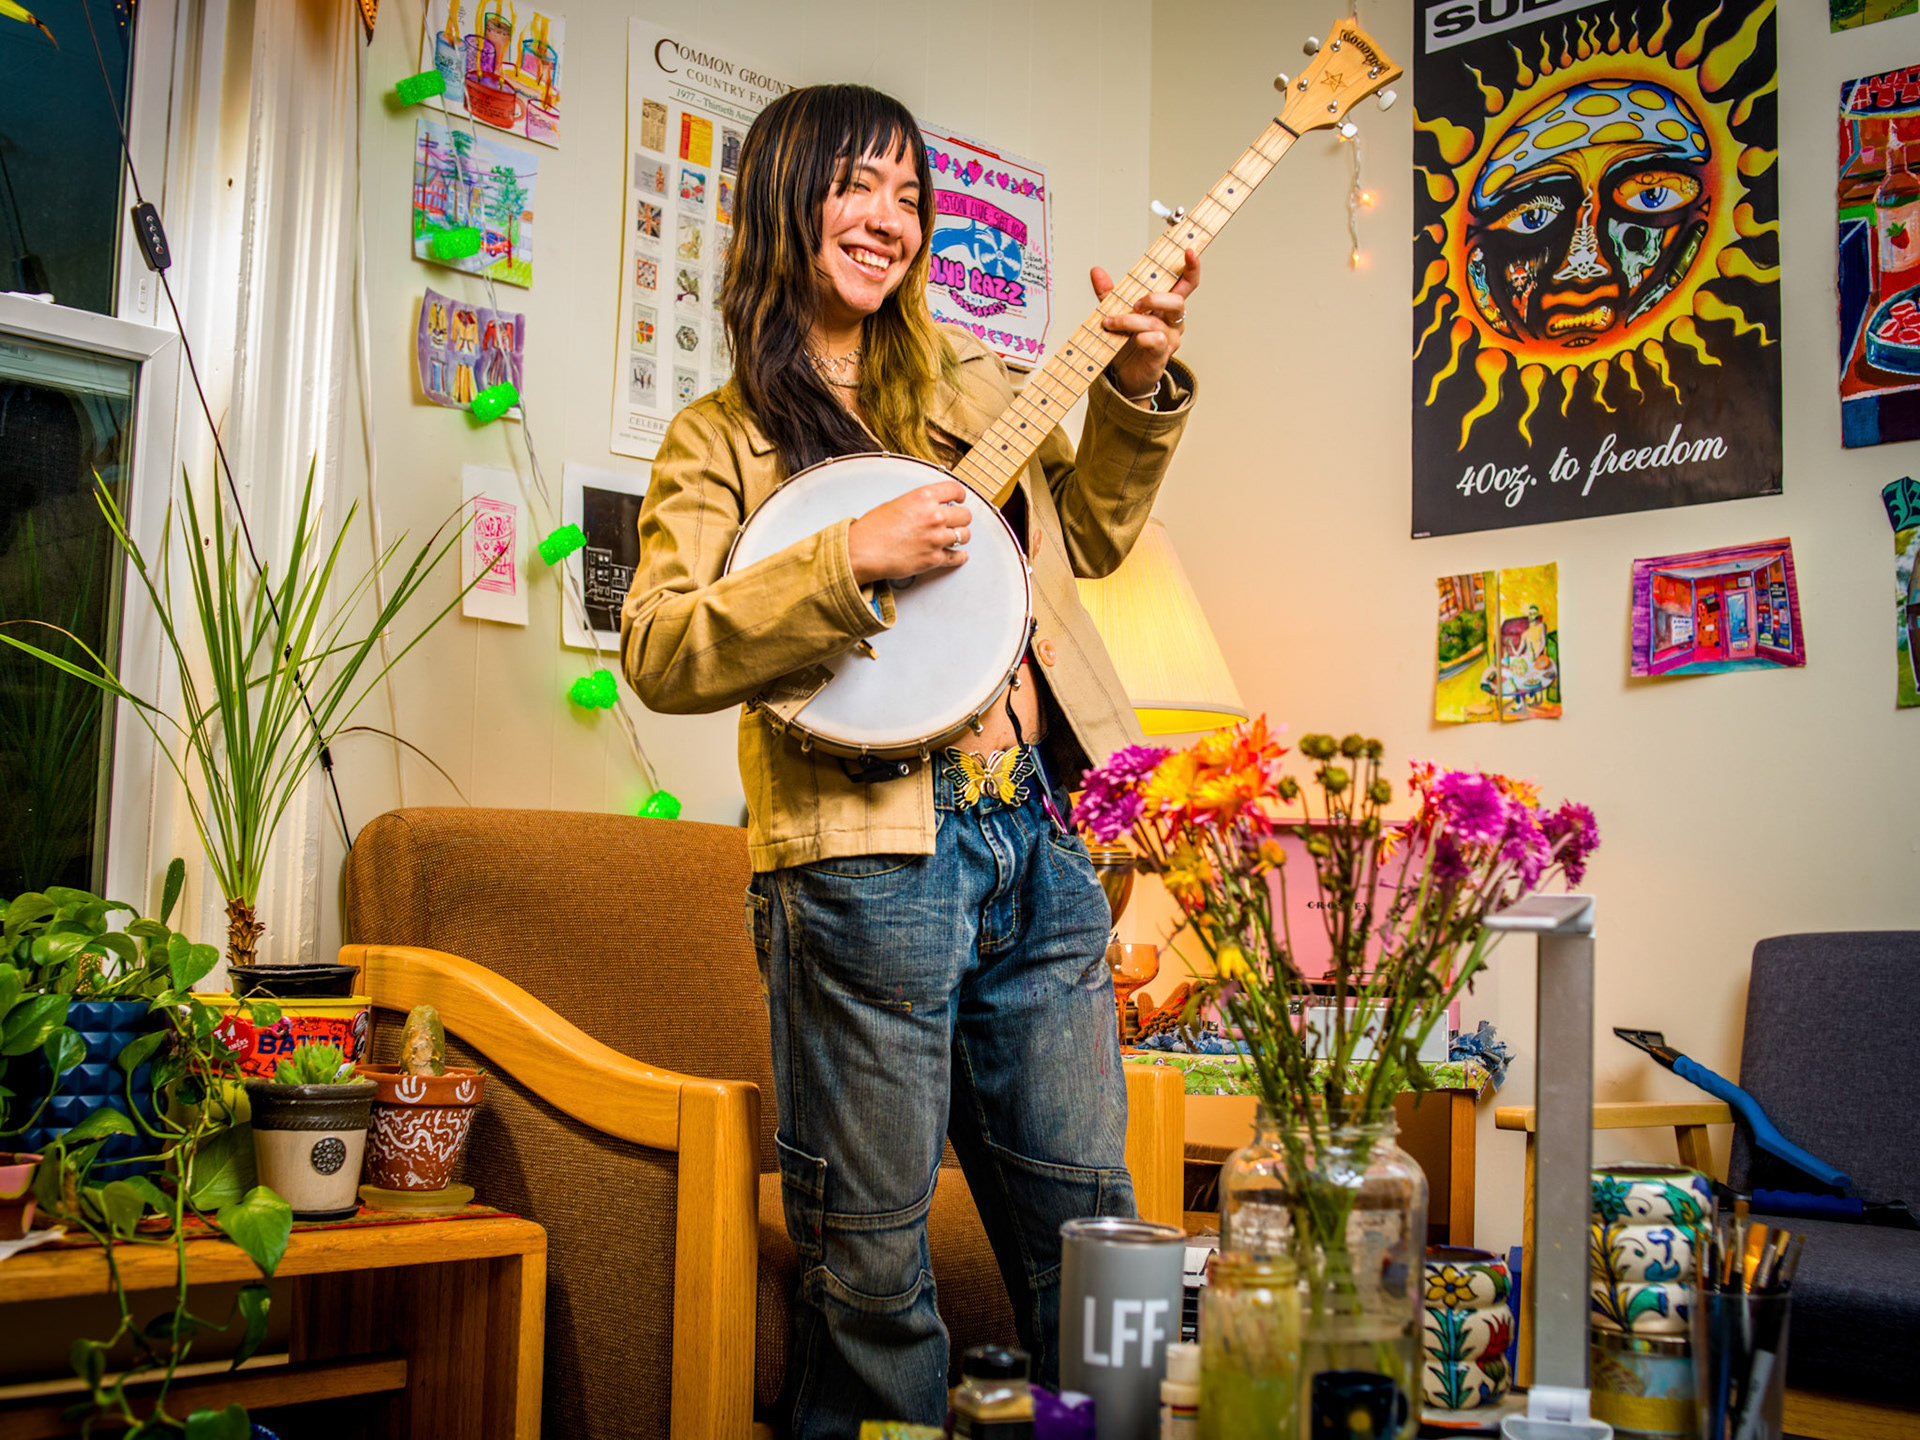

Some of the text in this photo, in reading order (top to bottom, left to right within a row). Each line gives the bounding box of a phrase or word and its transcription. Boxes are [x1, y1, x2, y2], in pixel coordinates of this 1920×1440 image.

[654, 38, 735, 75] COMMON
[676, 88, 696, 102] 1977
[686, 68, 772, 107] COUNTRY FAI
[969, 266, 1025, 307] RAZZ
[1456, 423, 1728, 508] 40oz. to freedom
[1083, 1296, 1170, 1368] LFF
